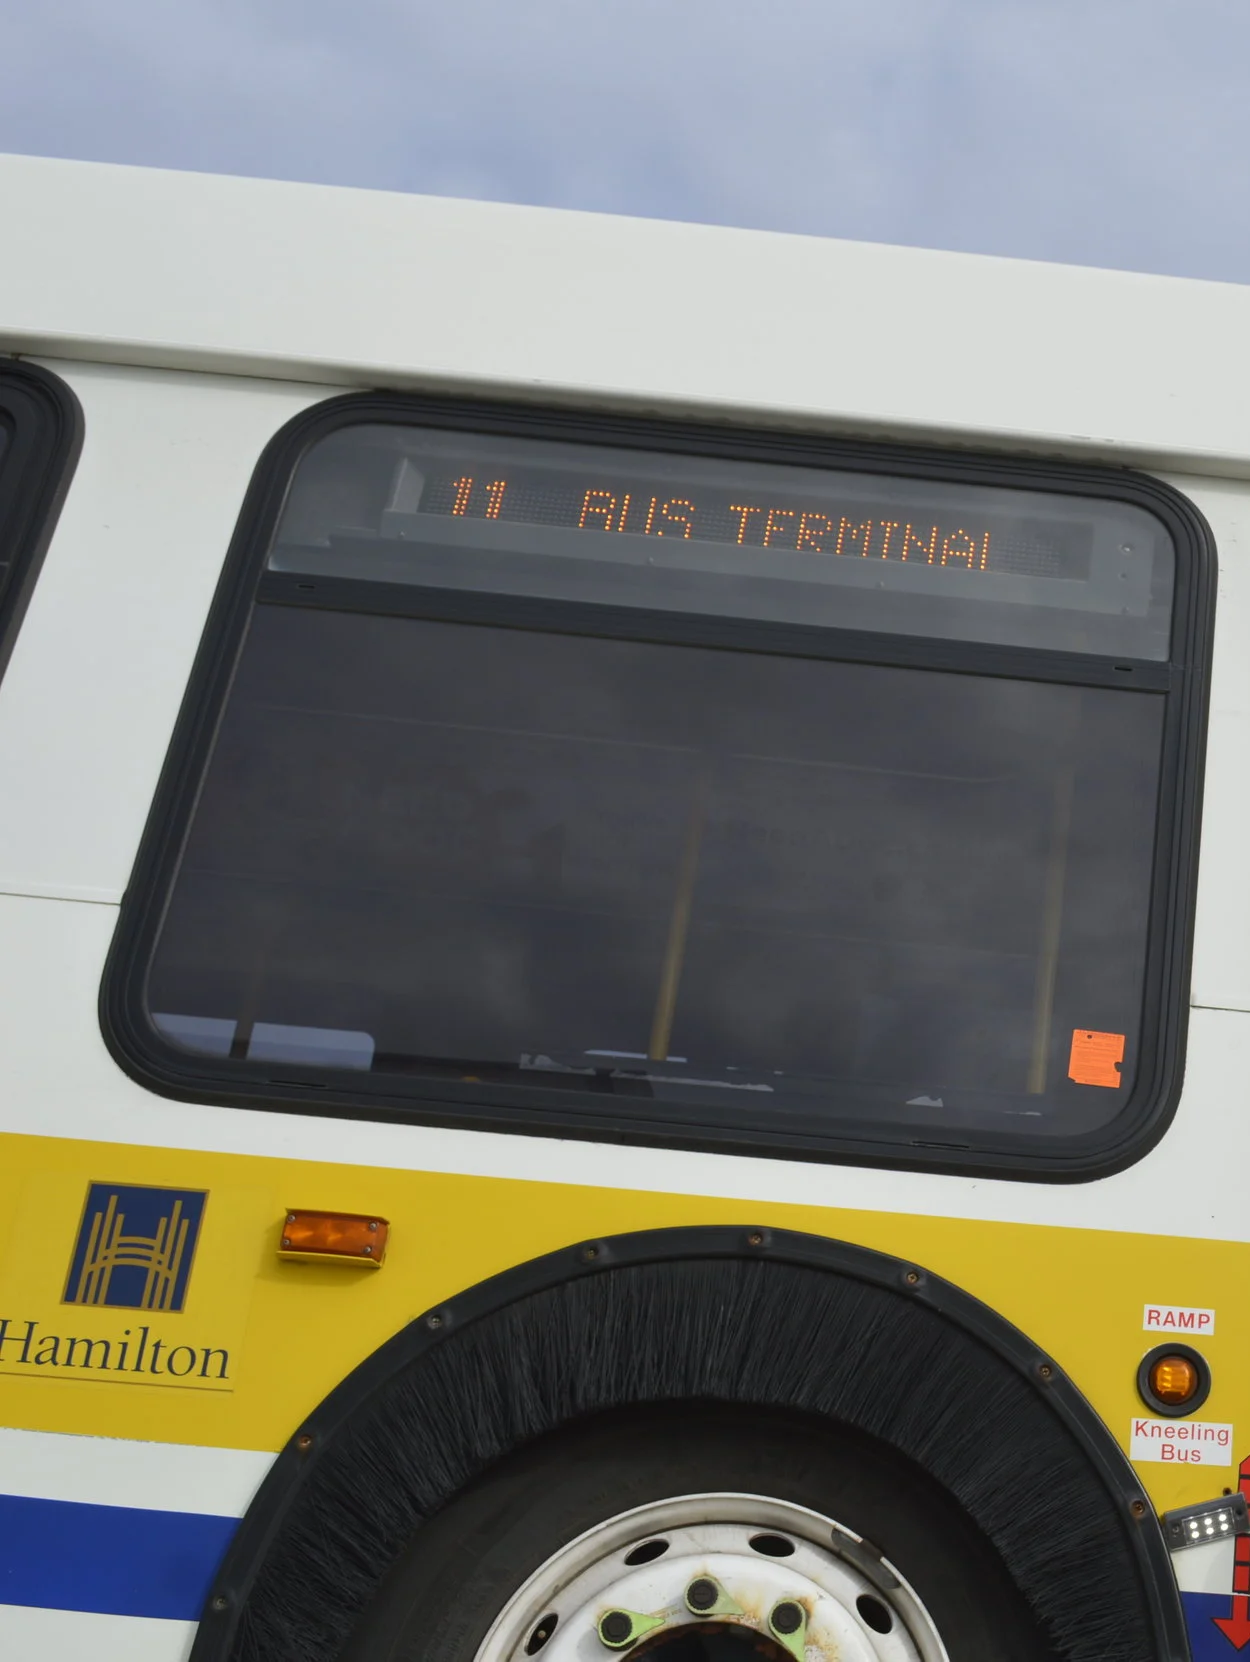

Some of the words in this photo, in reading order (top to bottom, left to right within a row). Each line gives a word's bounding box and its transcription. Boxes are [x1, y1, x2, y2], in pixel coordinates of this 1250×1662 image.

[452, 477, 507, 520] 11
[1147, 1309, 1211, 1329] RAMP
[0, 1318, 230, 1379] Hamilton
[1134, 1420, 1230, 1446] Kneeling
[1160, 1443, 1202, 1463] Bus
